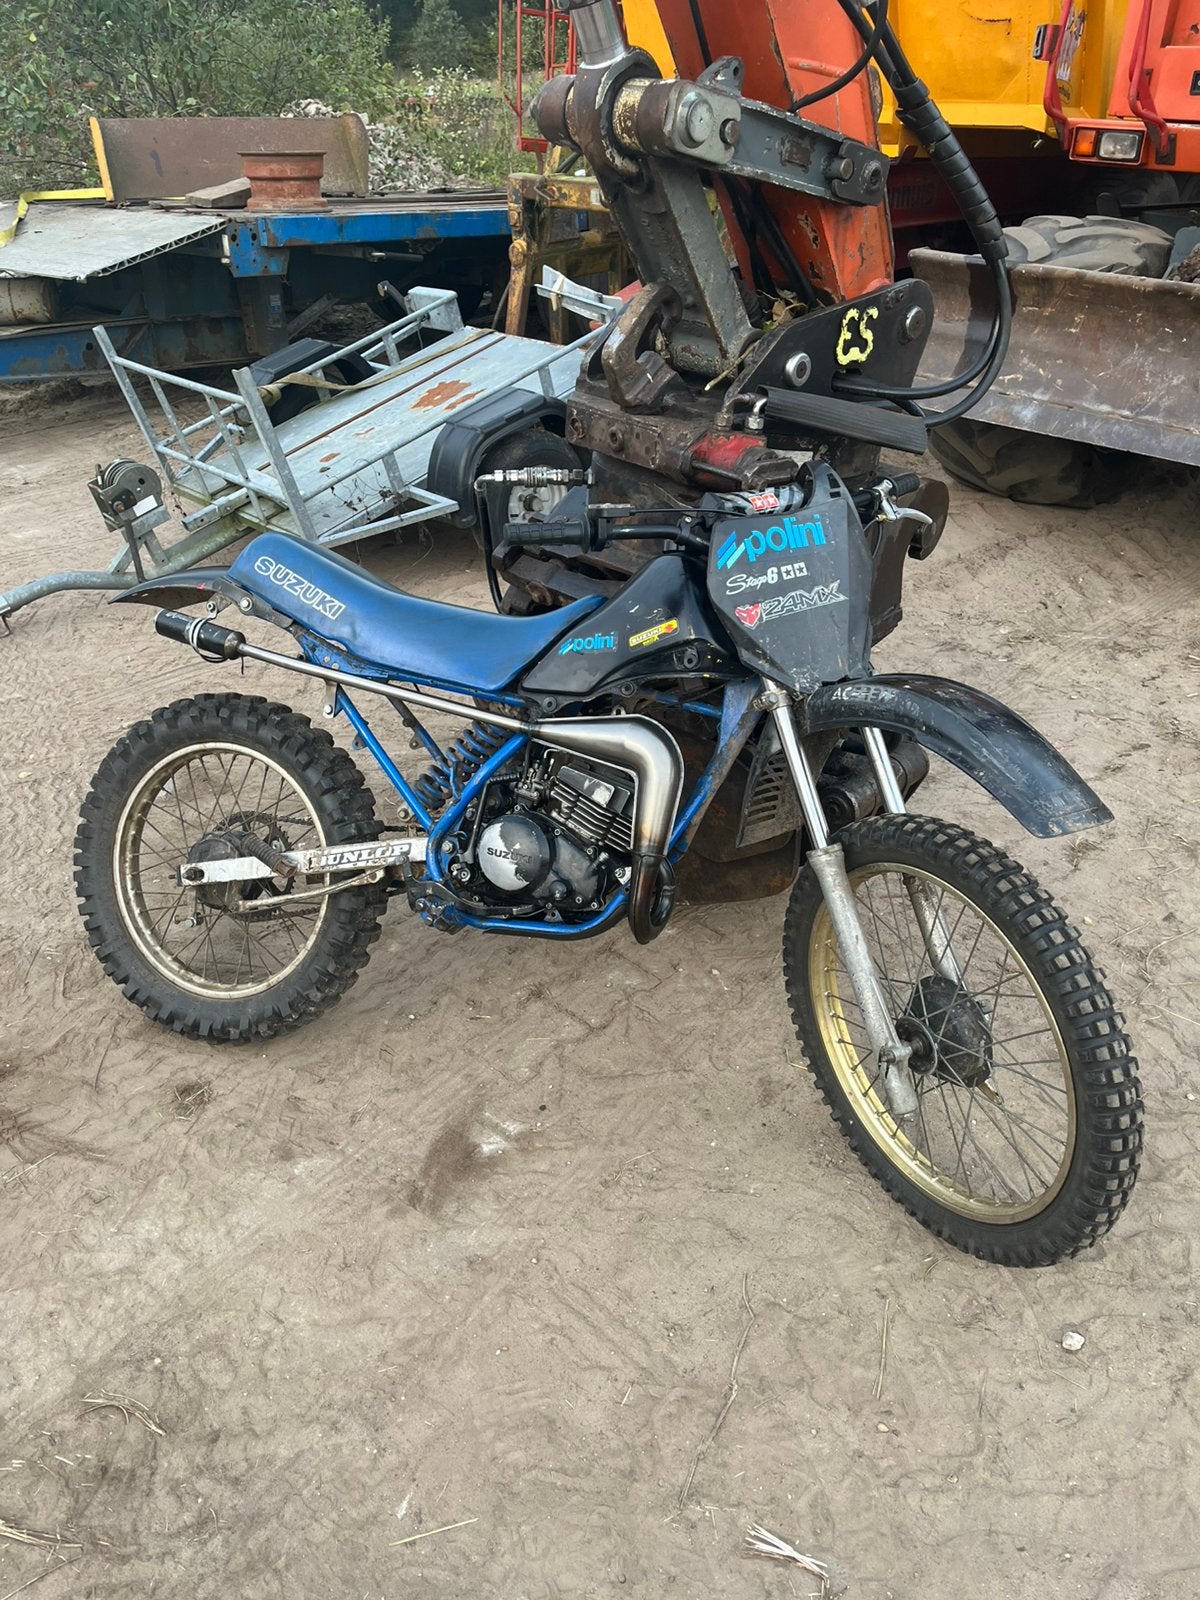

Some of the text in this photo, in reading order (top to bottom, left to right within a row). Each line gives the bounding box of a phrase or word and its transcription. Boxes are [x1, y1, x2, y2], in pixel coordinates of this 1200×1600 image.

[744, 514, 827, 562] polini
[254, 556, 347, 620] SUZUKI
[762, 580, 848, 620] 24MX
[572, 632, 615, 652] polini
